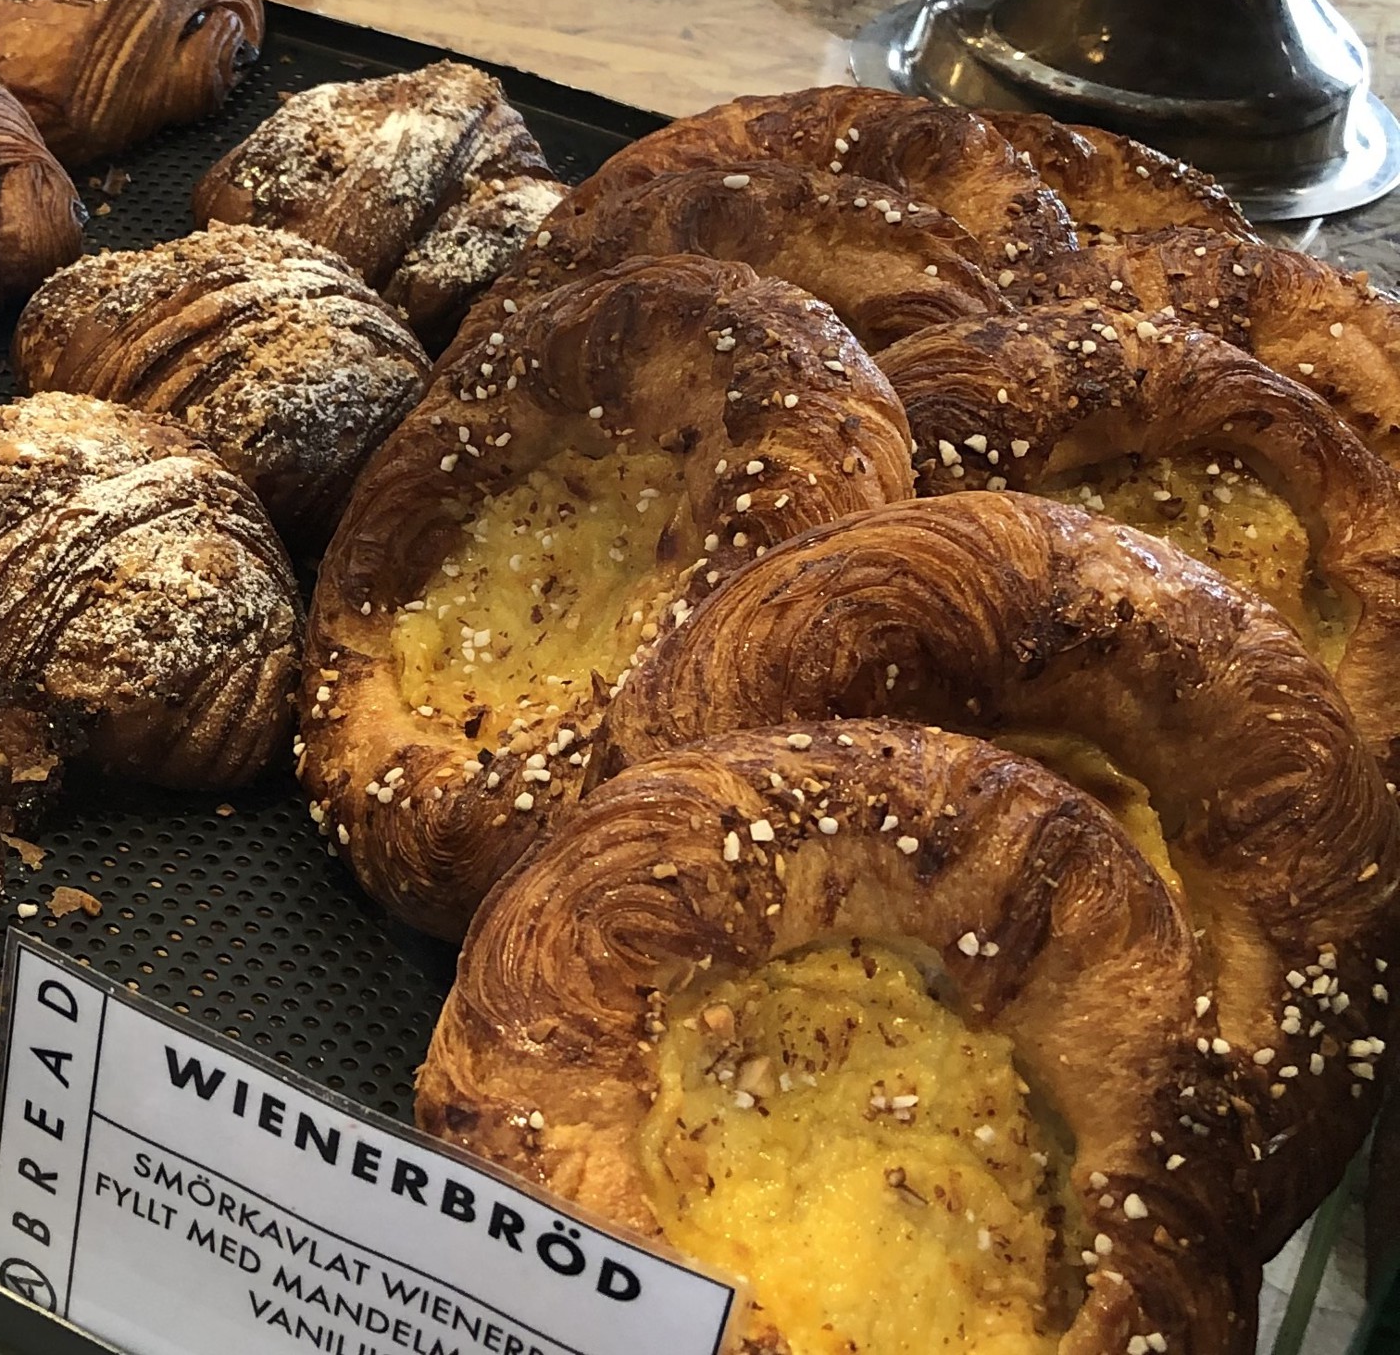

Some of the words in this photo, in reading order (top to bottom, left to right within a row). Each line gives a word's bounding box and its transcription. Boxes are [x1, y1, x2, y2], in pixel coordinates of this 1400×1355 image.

[11, 978, 79, 1247] BREAD
[163, 1044, 642, 1304] WIENERBRÖD
[95, 1175, 178, 1230] FYLLT
[186, 1219, 262, 1273] MED
[132, 1152, 371, 1285] SMÖRKAVLAT
